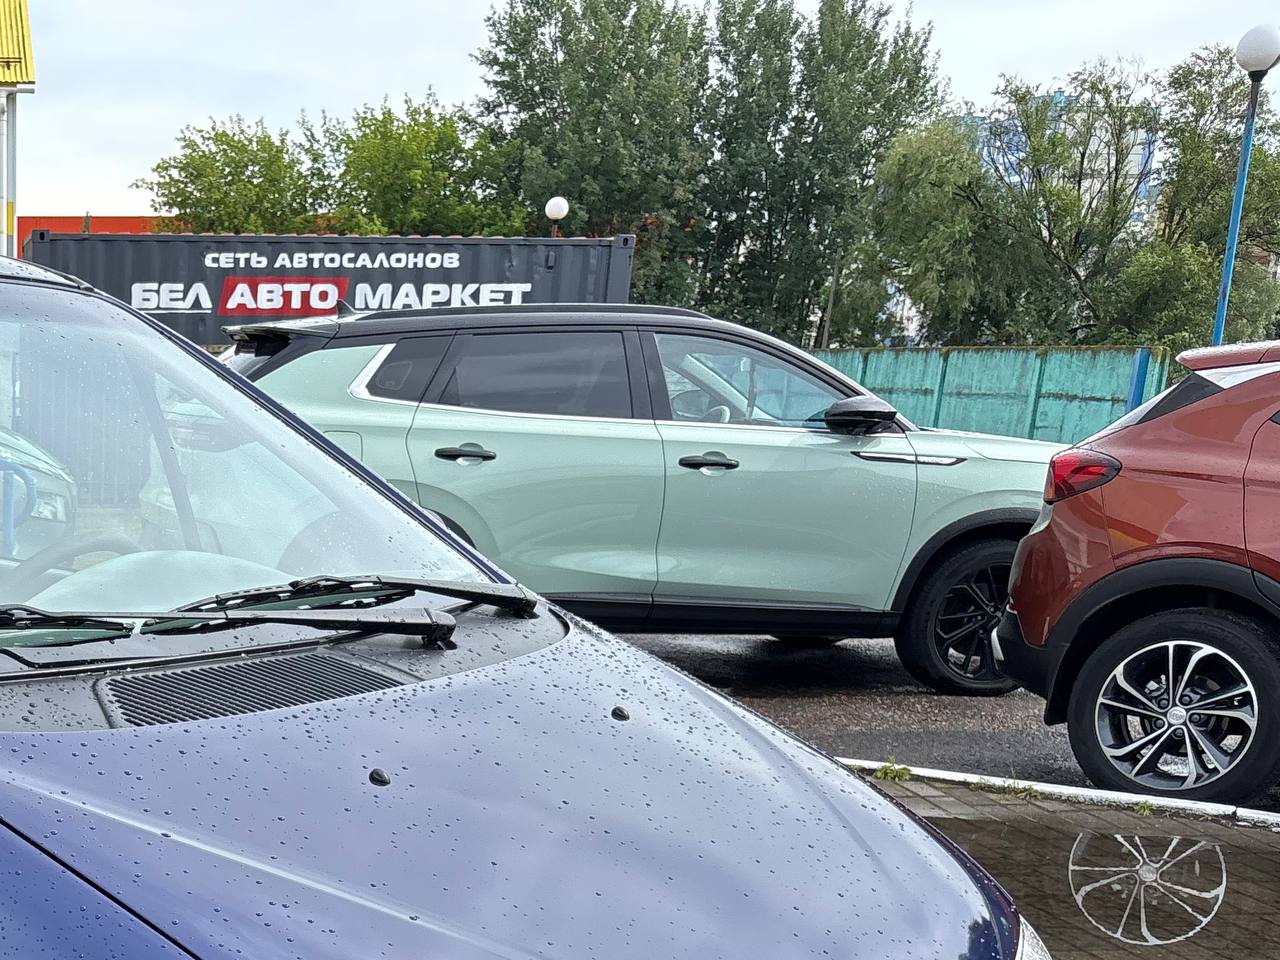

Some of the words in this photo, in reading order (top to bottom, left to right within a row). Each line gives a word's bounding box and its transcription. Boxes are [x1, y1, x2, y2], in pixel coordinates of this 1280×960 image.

[204, 252, 268, 269] СЕТЬ
[273, 252, 461, 269] АВТОСАЛОНОВ
[131, 282, 213, 309] БЕЛ
[225, 283, 339, 309] АВТО
[354, 283, 533, 309] МАРКЕТ
